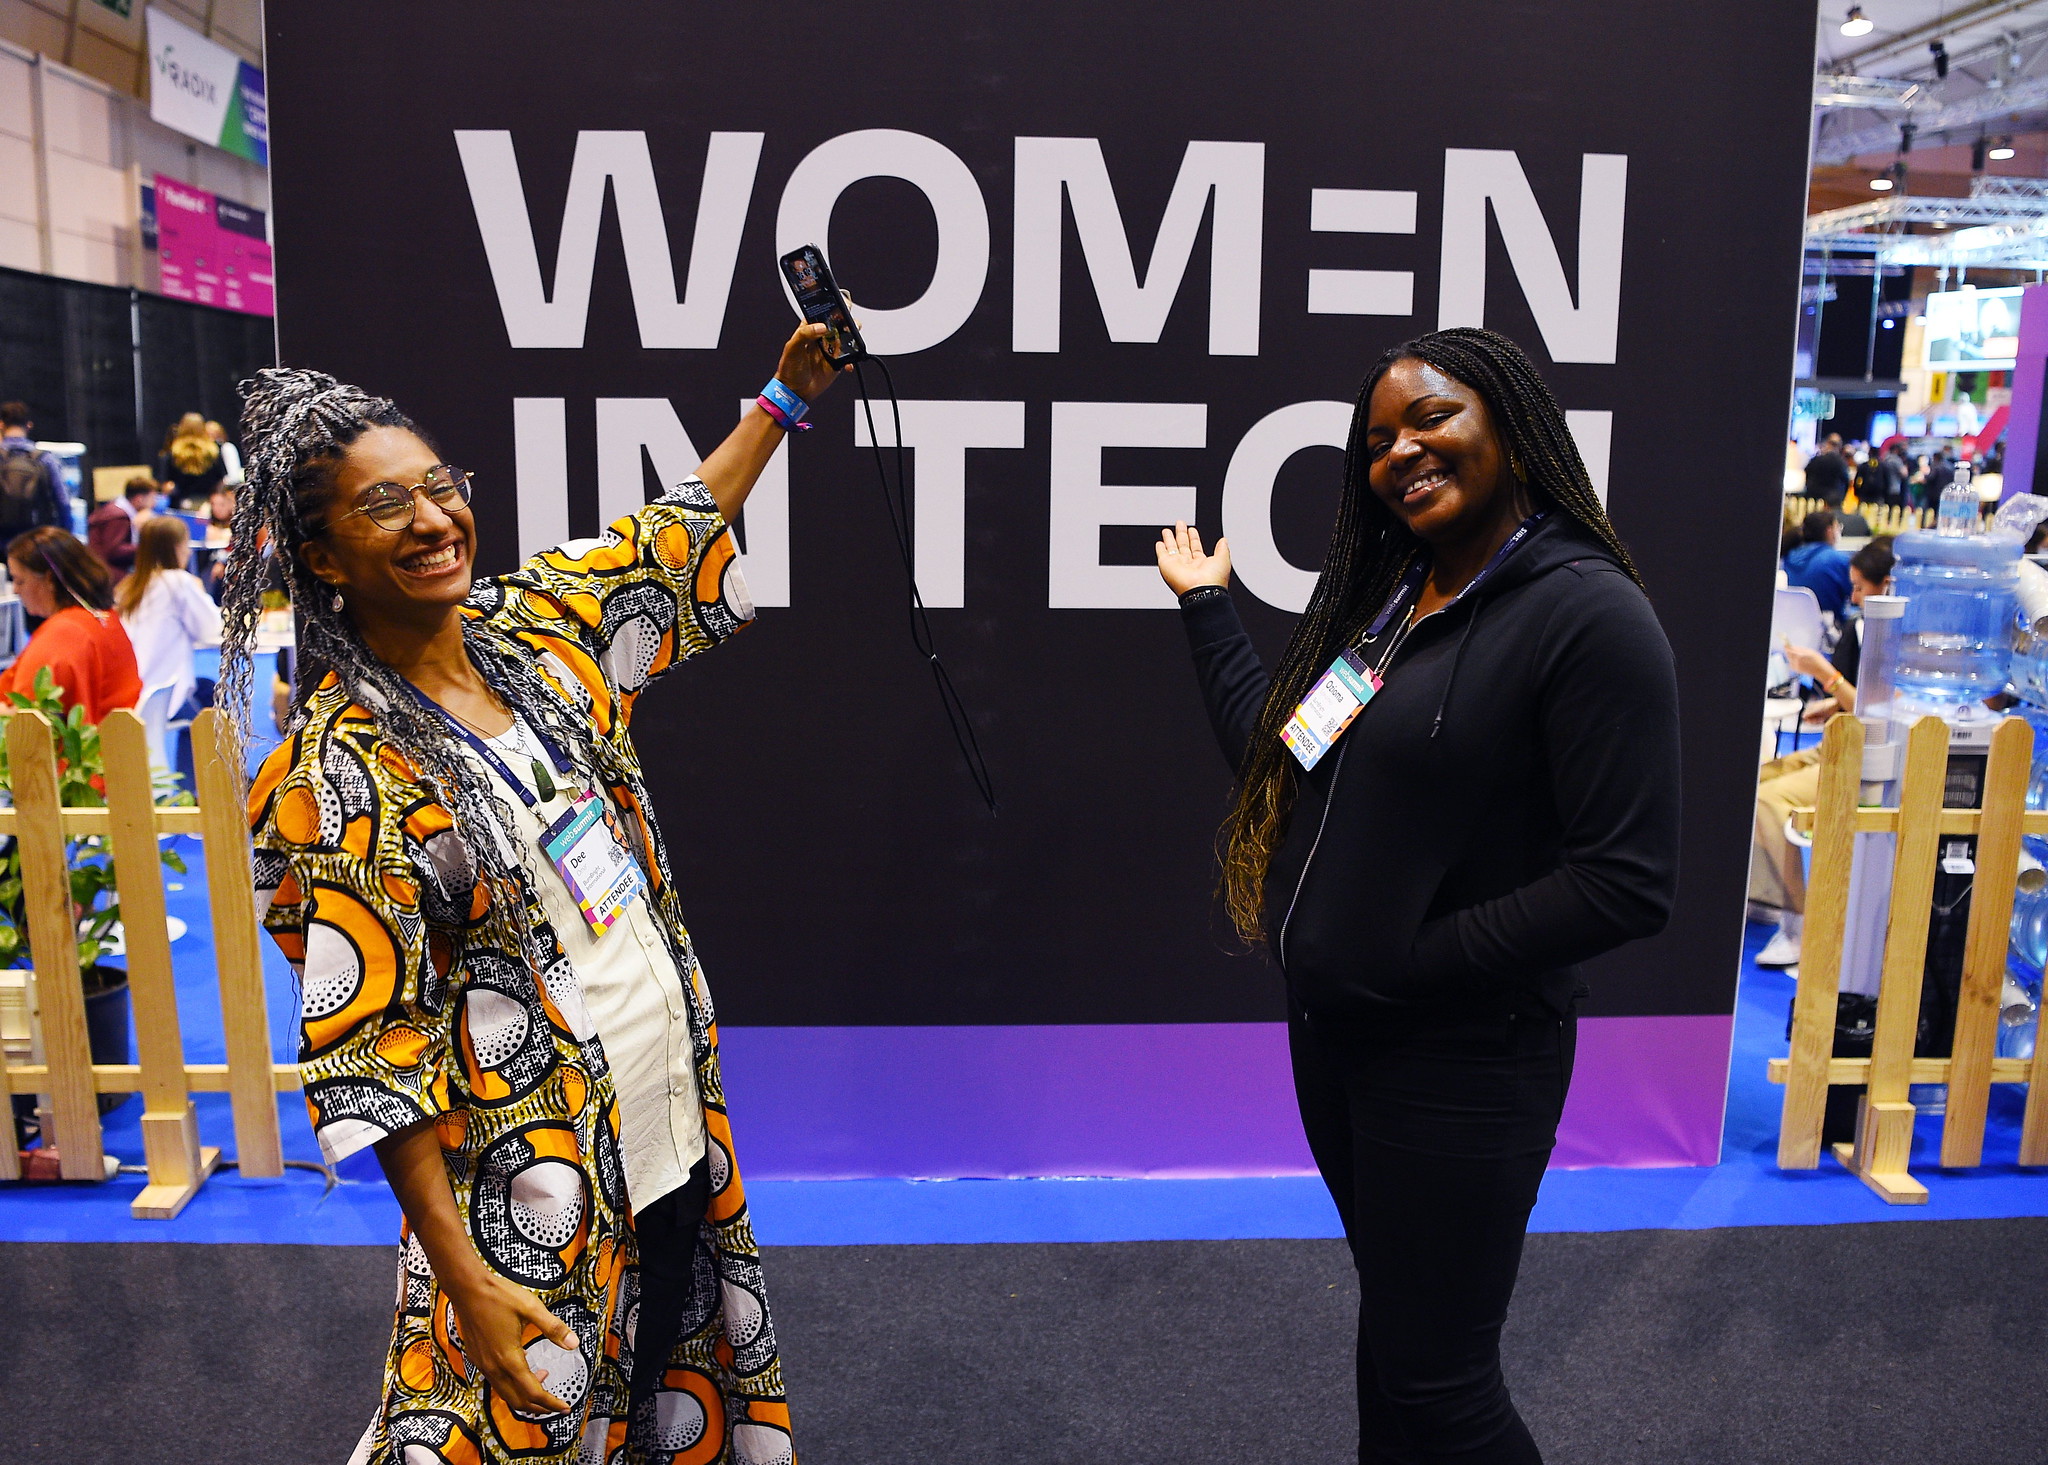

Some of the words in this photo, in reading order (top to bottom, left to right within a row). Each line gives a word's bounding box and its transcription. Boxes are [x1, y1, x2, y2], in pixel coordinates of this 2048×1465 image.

[855, 399, 1613, 611] TEC
[1326, 680, 1344, 703] Ozioma
[1289, 723, 1316, 754] ATTENDEE
[570, 851, 587, 869] Dee
[599, 874, 635, 917] ATTENDEE
